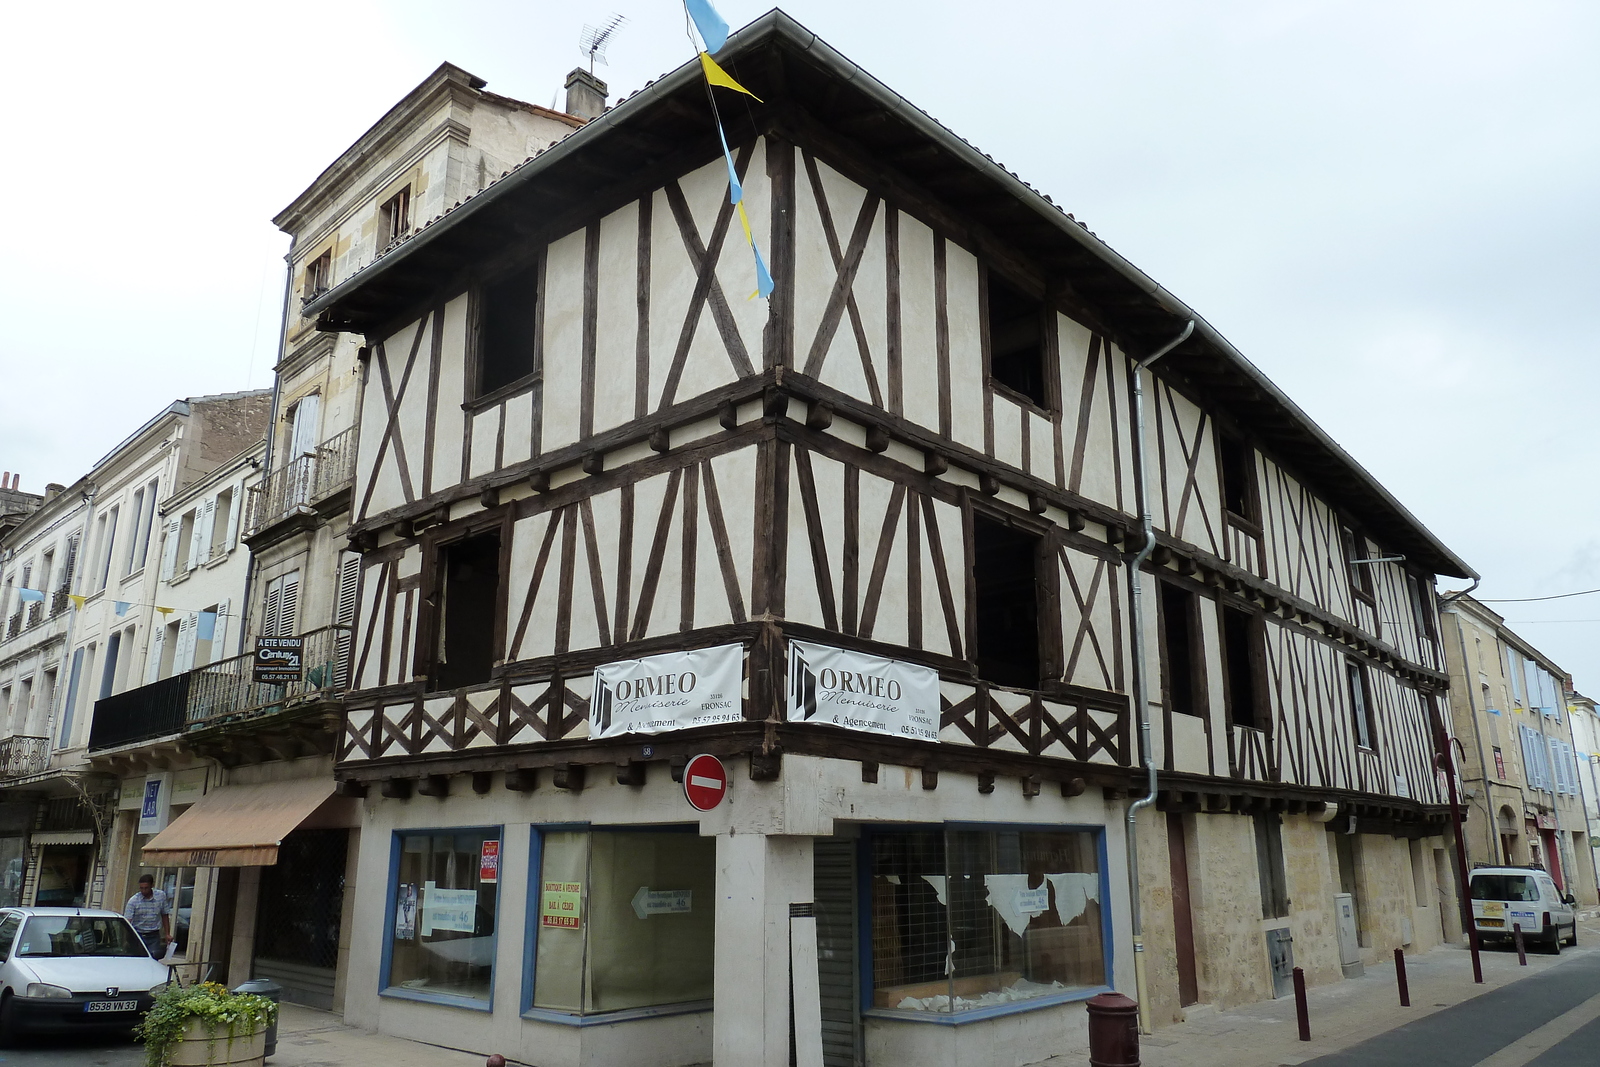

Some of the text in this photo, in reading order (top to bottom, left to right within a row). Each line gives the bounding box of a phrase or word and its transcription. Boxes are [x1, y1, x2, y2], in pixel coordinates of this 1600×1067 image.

[279, 639, 301, 647] VENDU
[259, 648, 293, 660] Century
[288, 656, 300, 666] 21
[616, 671, 696, 700] ORMEO
[820, 668, 902, 700] ORMEO
[701, 700, 732, 710] FRONSAC
[819, 690, 899, 713] Menuiserie
[702, 716, 712, 724] 57
[832, 714, 887, 730] & Agencement
[627, 722, 634, 731] &
[901, 725, 909, 734] 05
[566, 884, 580, 893] VENDRE
[676, 898, 686, 906] 46
[459, 911, 468, 922] 46
[90, 1002, 136, 1011] 8538 VN 33
